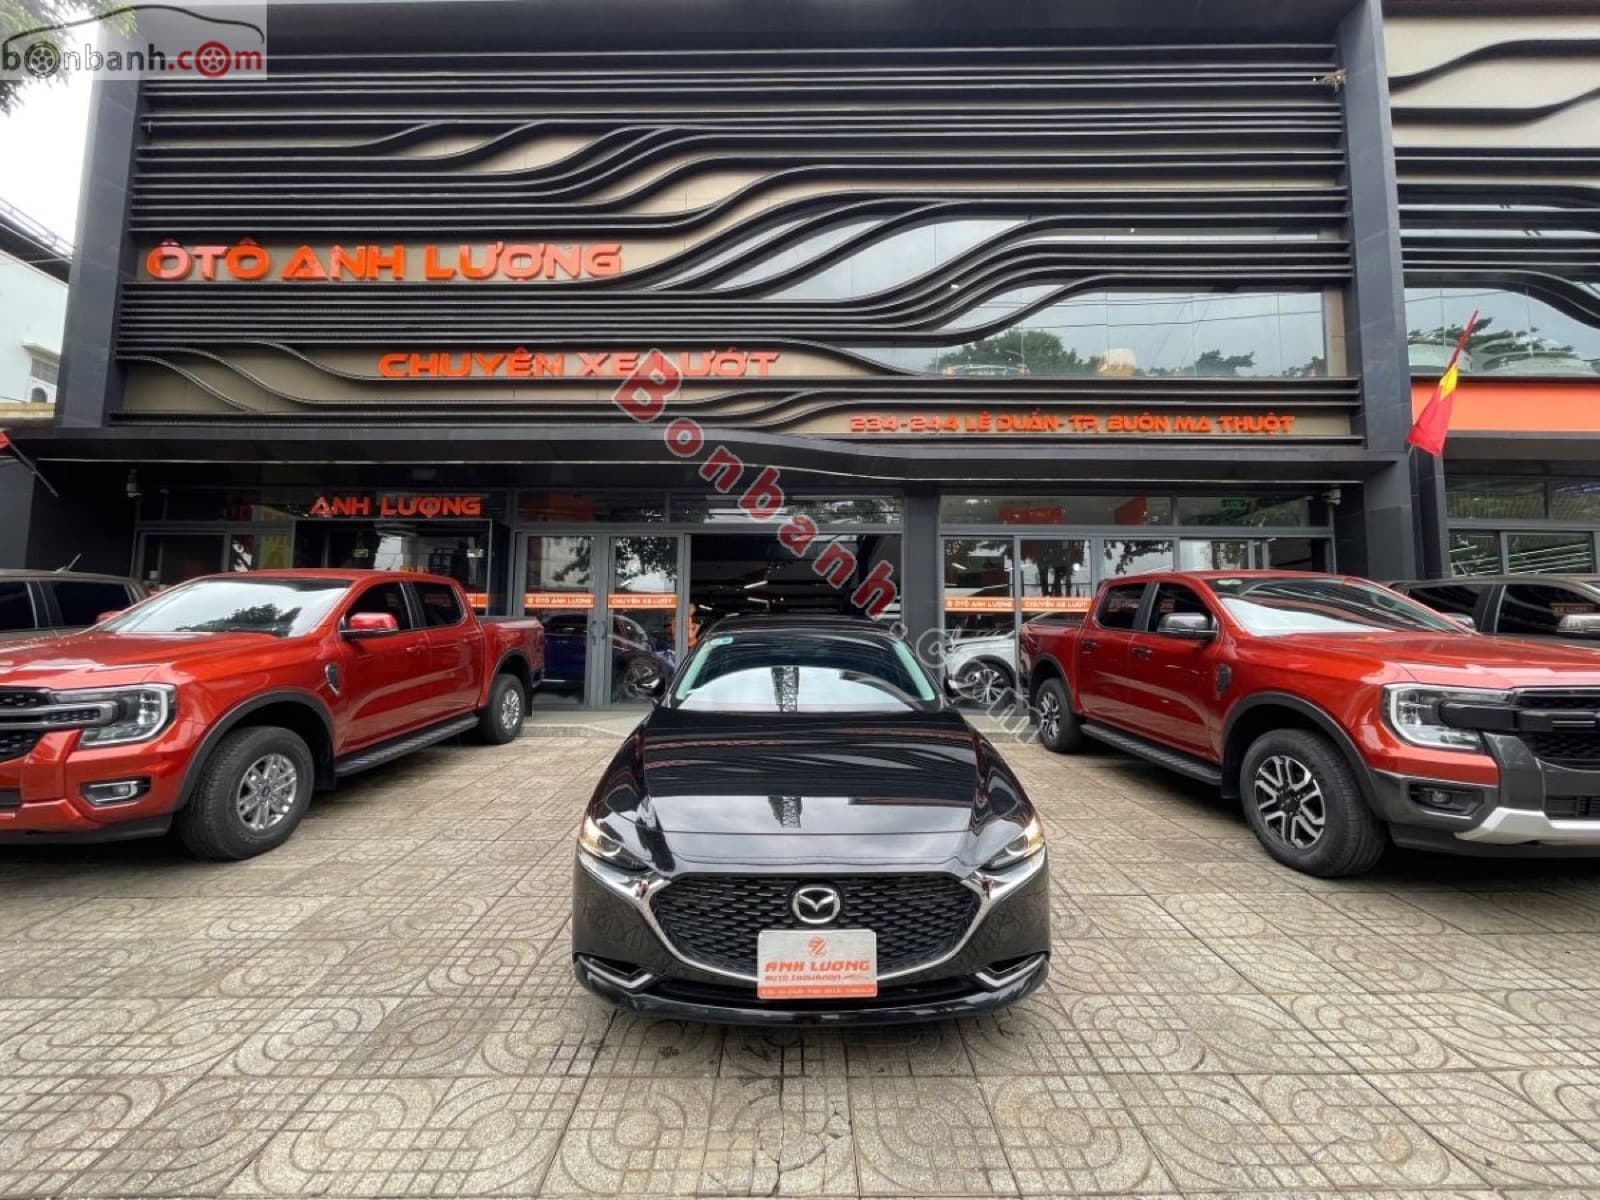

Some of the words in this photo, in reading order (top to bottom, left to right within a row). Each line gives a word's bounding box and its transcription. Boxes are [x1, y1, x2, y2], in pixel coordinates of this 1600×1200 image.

[146, 238, 272, 281] ÔTÔ
[281, 244, 406, 281] ANH
[425, 241, 622, 283] LƯỢNG
[377, 347, 566, 378] CHUYÊN
[576, 352, 640, 378] XE
[964, 411, 991, 432] LÊ
[1107, 412, 1168, 432] BUÔN
[1173, 416, 1212, 432] MA
[1217, 412, 1295, 434] THUỘT
[310, 497, 371, 516] ANH
